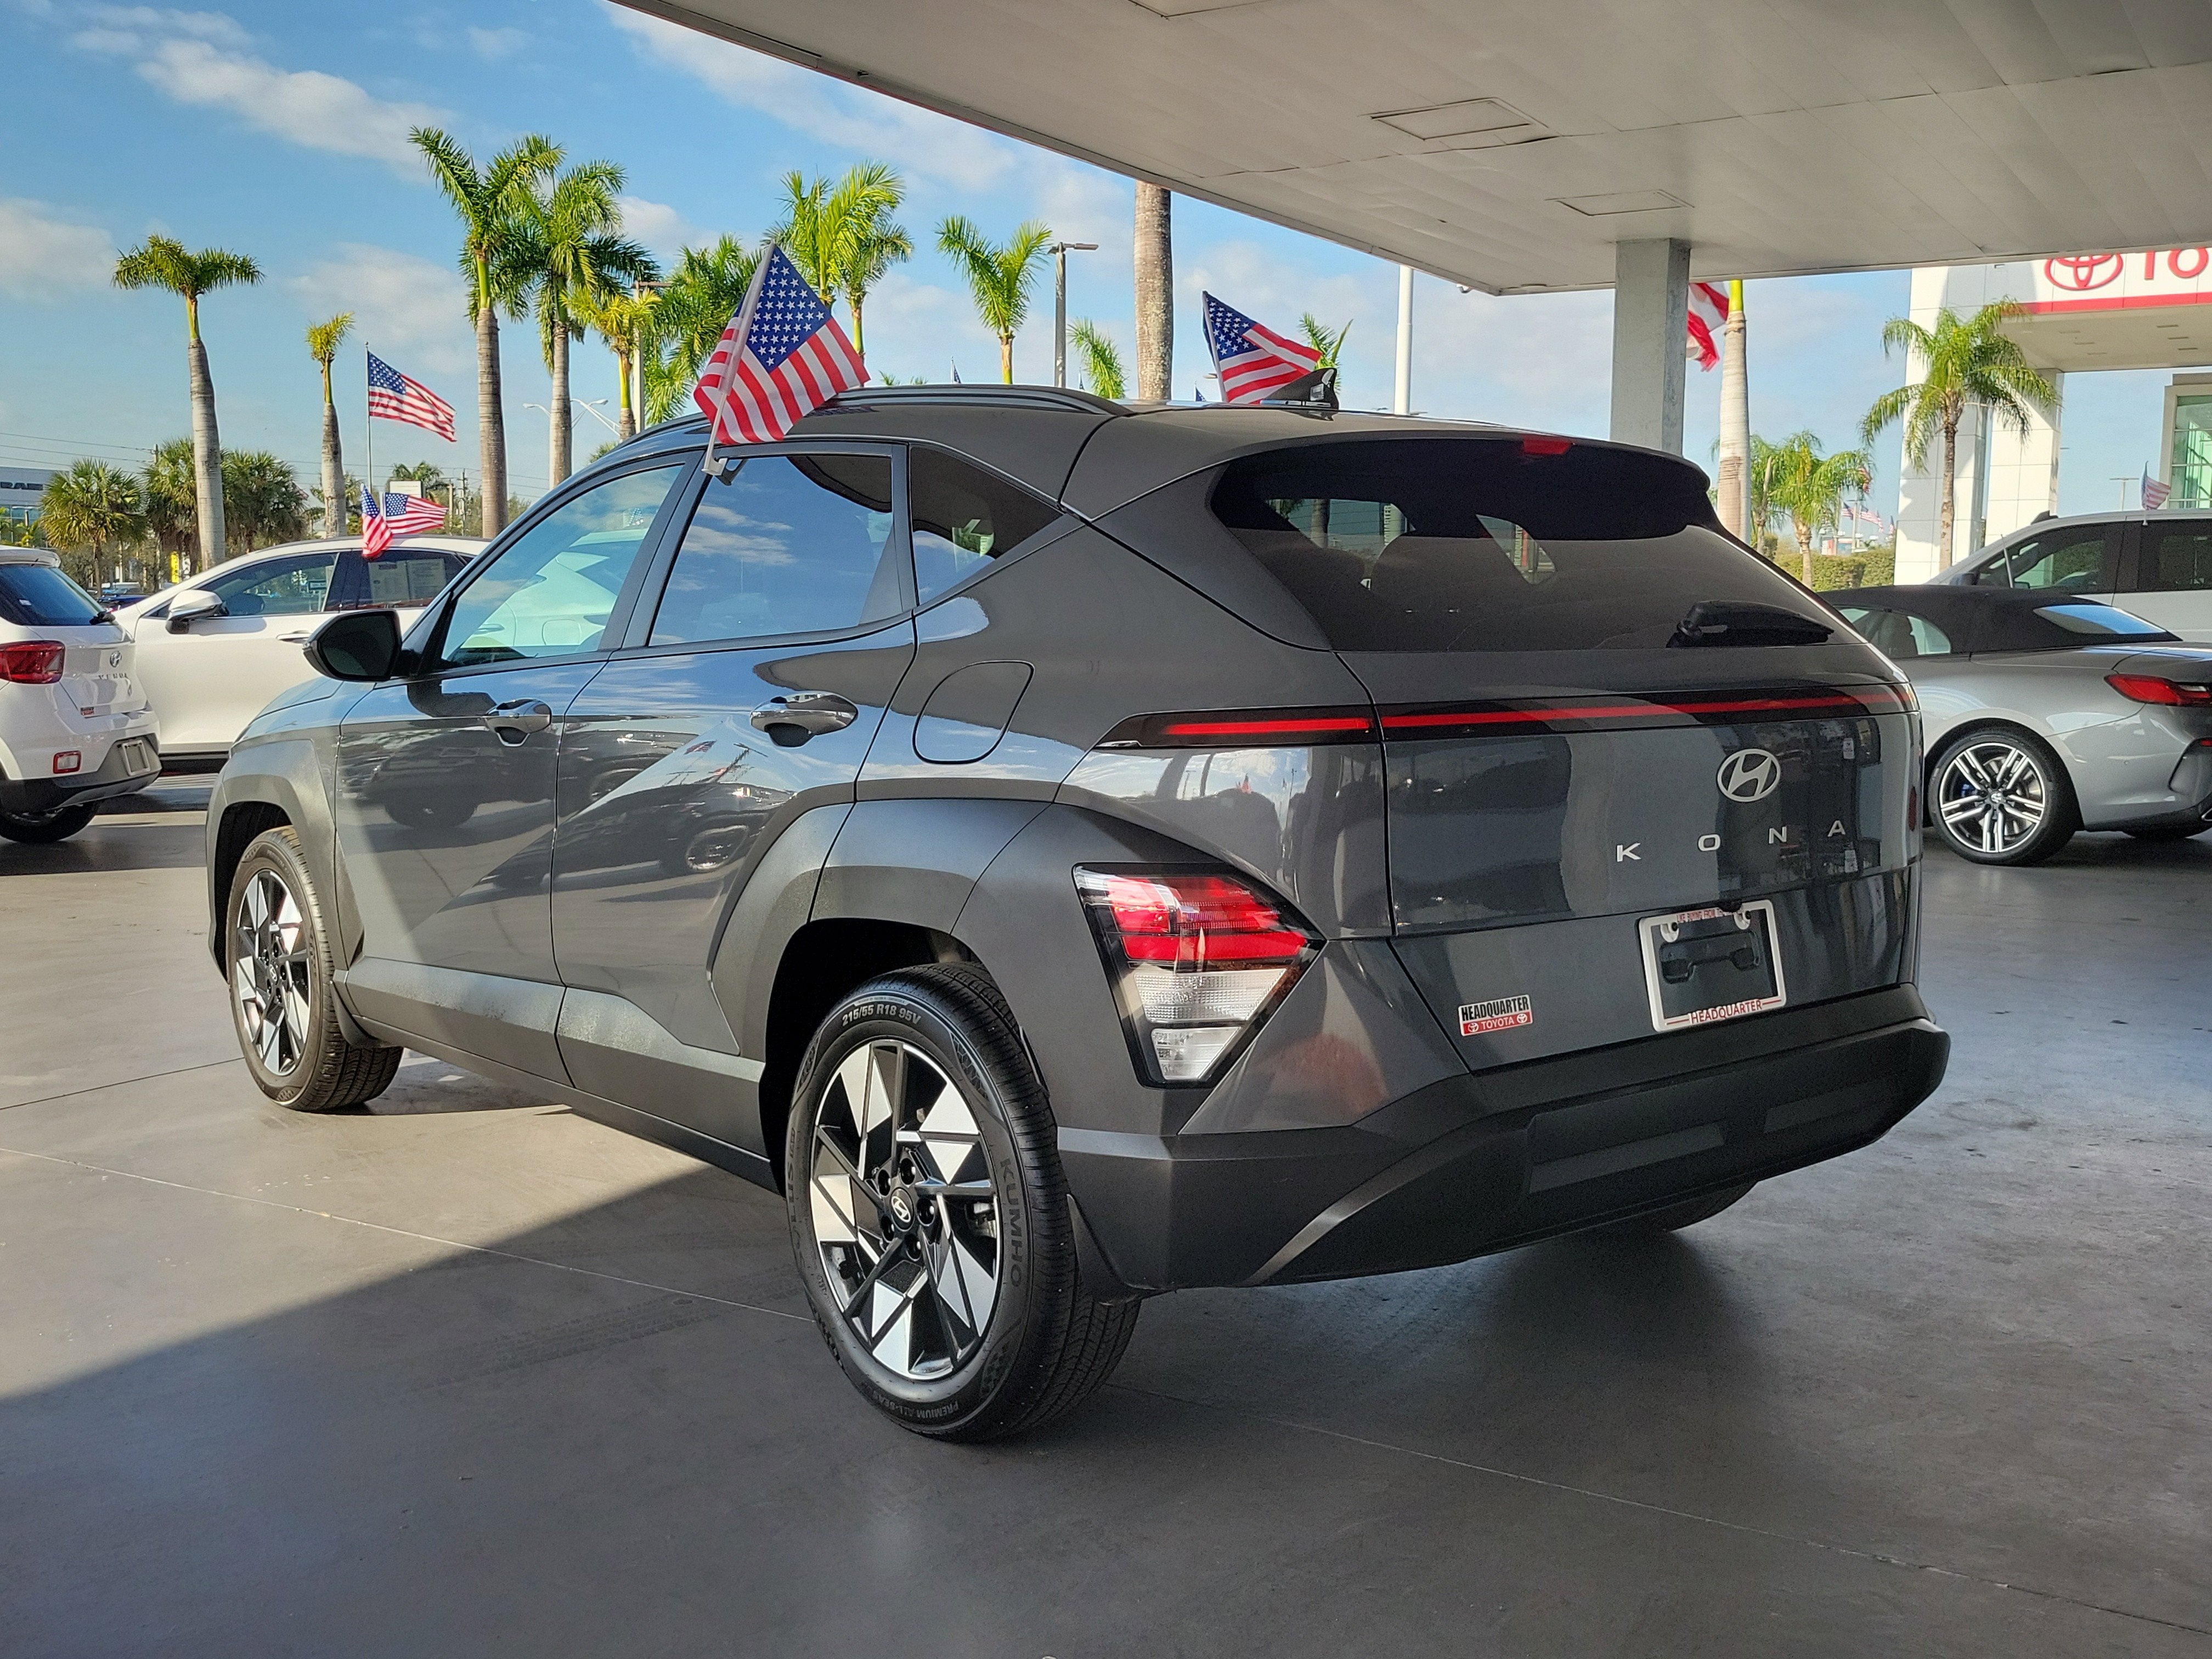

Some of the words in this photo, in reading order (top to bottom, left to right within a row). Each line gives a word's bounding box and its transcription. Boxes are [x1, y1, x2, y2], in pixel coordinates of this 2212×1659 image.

[1616, 820, 1846, 862] KONA
[842, 1005, 874, 1026] 215/55
[877, 1003, 897, 1015] R18
[899, 1007, 922, 1024] 95V
[1461, 996, 1529, 1022] HEADQUARTER
[1690, 1000, 1763, 1024] HEADQUARTER
[1481, 1016, 1515, 1030] TOYOTA
[1000, 1158, 1023, 1288] KUMHO
[916, 1400, 959, 1419] PREMIUM
